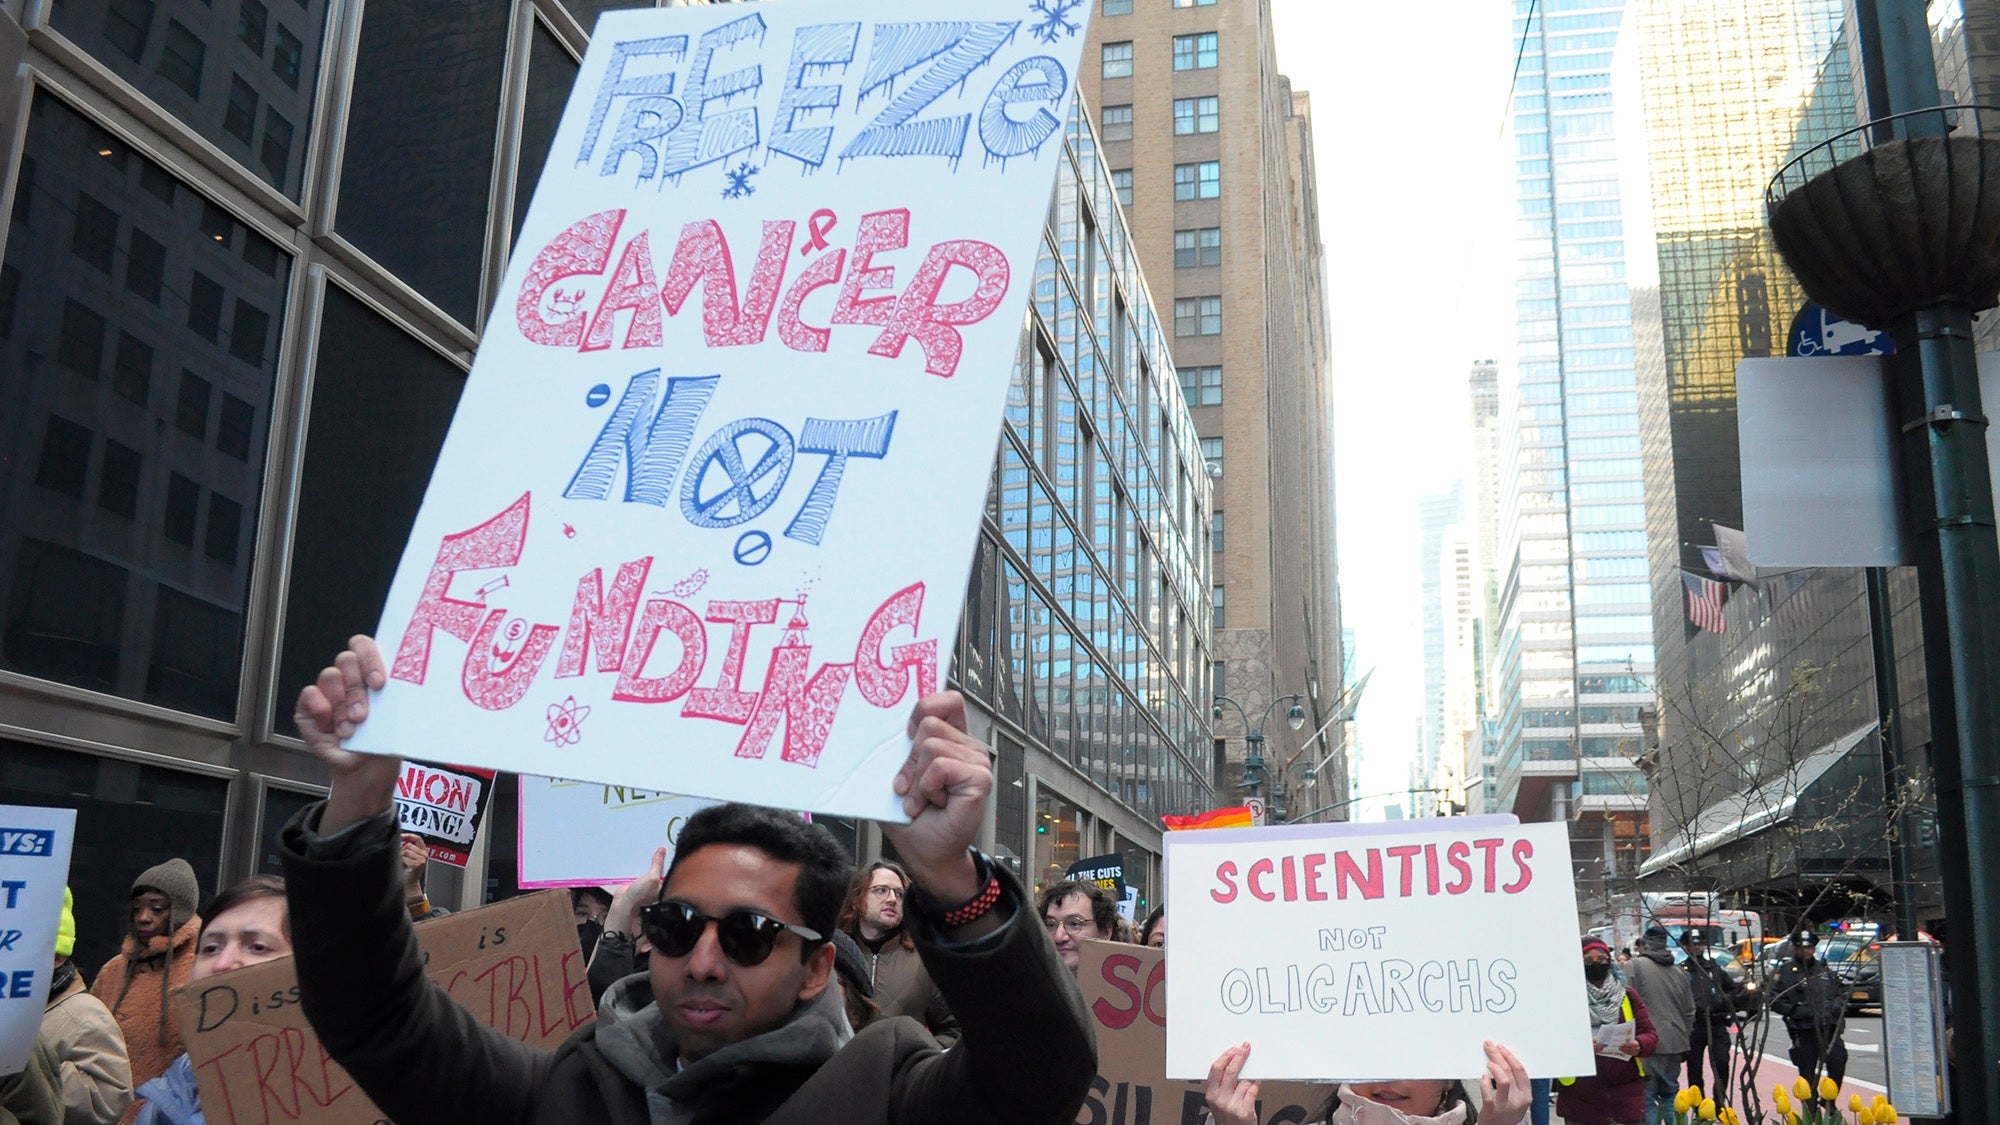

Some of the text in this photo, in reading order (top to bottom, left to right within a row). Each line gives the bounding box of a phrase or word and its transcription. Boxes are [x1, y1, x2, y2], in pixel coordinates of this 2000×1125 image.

[515, 207, 1010, 379] CANCER
[562, 367, 899, 545] NOT
[390, 490, 939, 769] FUNDING
[397, 766, 472, 812] NION
[2, 832, 47, 854] YS:
[396, 802, 465, 838] RONG!
[1, 880, 27, 909] T
[1077, 869, 1095, 881] THE
[1097, 866, 1122, 880] CUTS
[1210, 838, 1533, 904] SCIENTISTS
[1318, 926, 1386, 951] NOT
[197, 927, 506, 1032] Diss is
[1221, 958, 1517, 1016] OLIGARCHS
